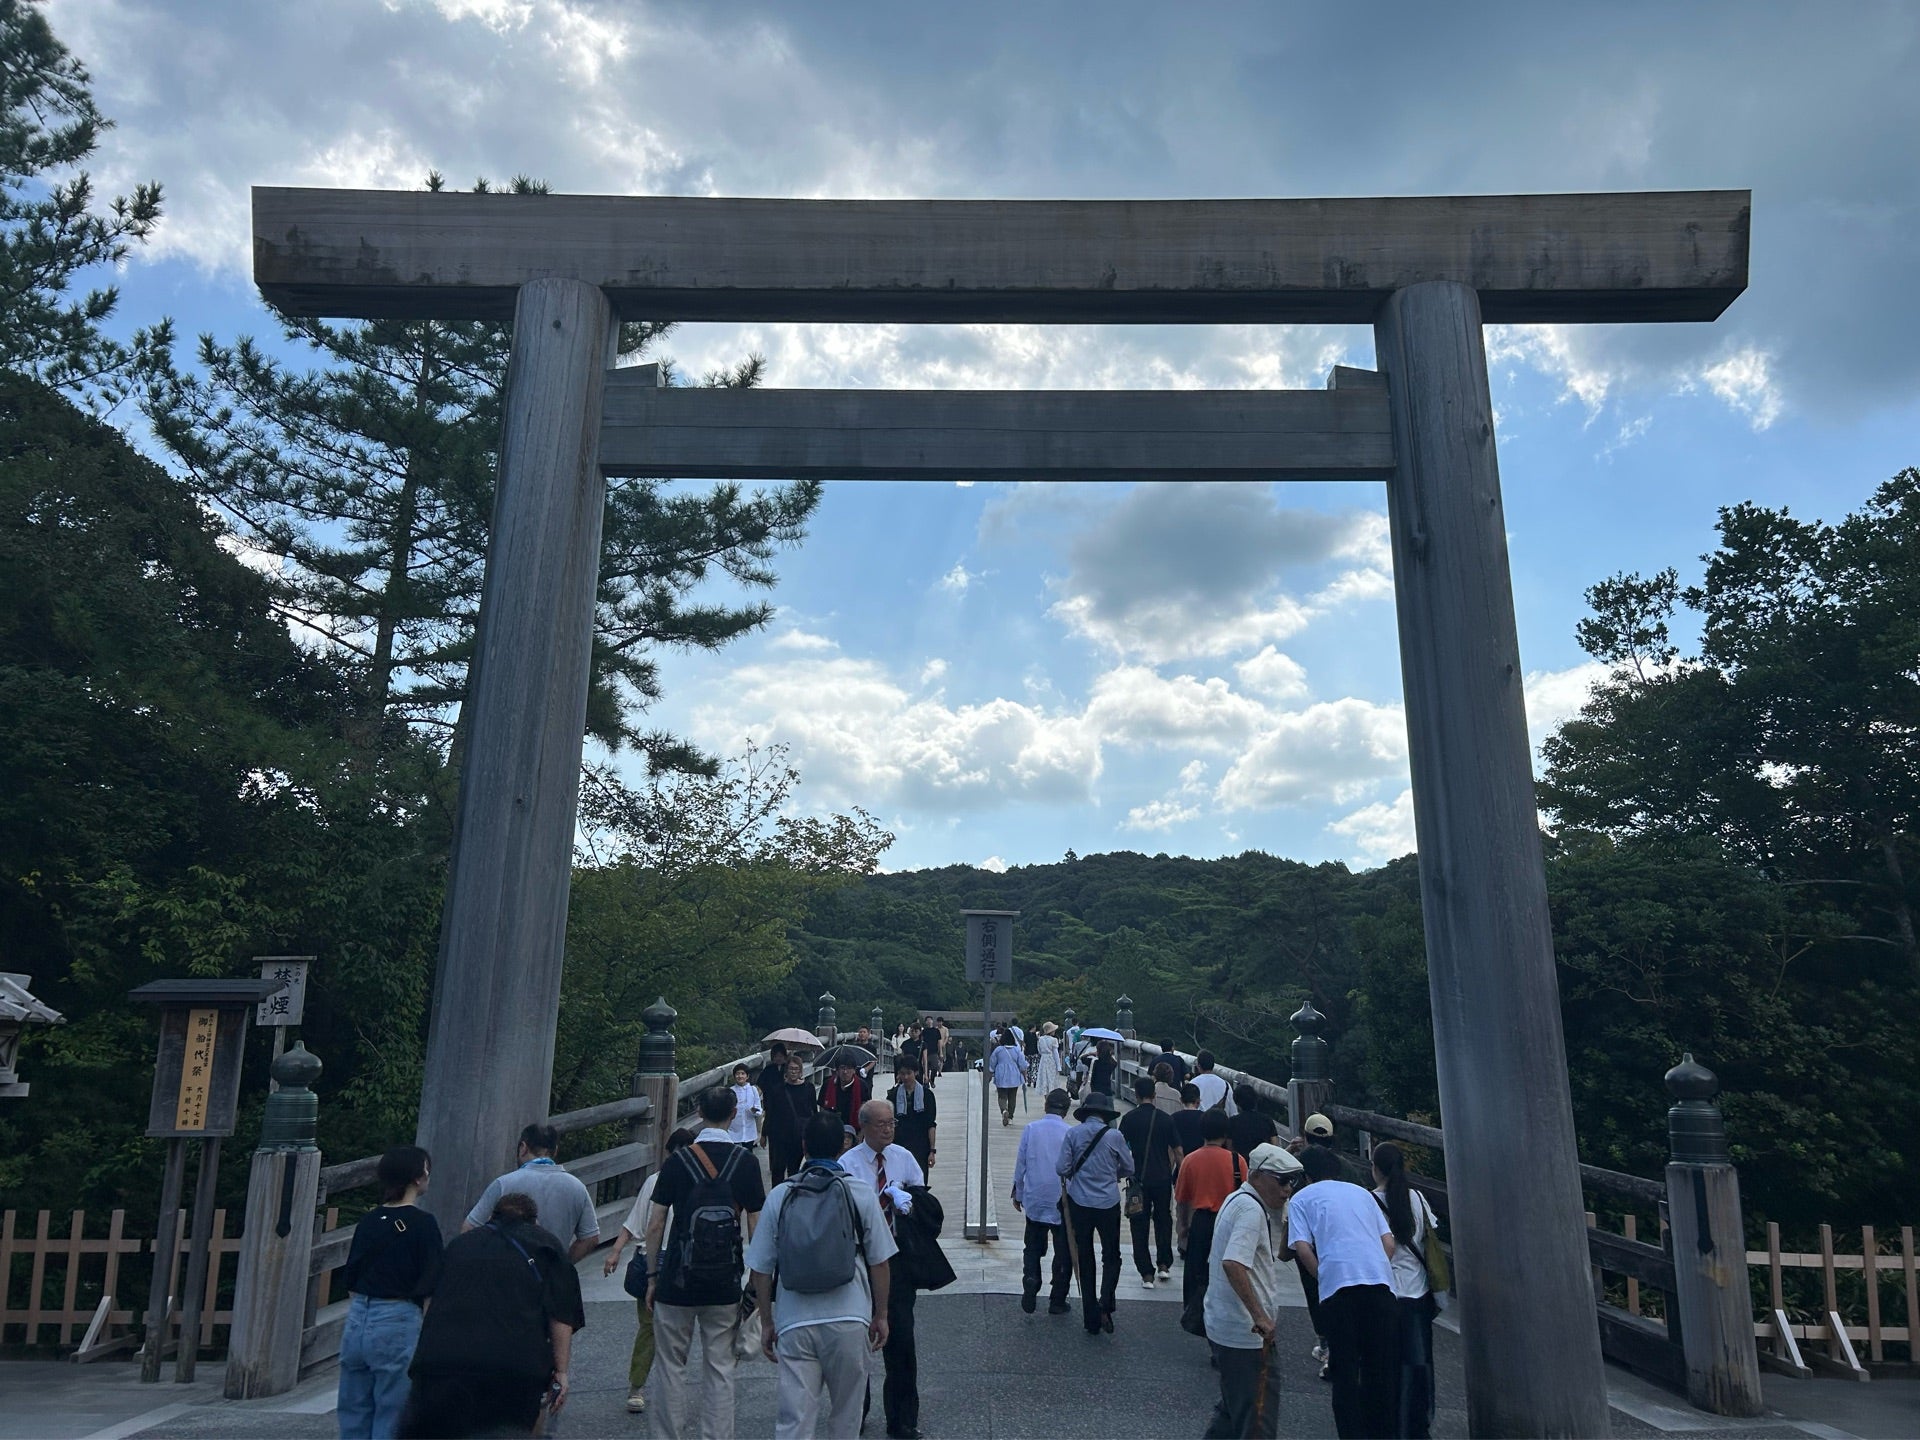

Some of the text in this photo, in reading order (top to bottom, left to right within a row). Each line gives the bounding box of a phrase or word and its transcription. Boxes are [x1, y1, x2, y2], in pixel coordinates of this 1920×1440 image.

[981, 918, 998, 978] 右側通行
[270, 967, 292, 1015] 禁煙
[261, 1007, 268, 1021] です
[193, 1086, 203, 1126] 九月十七日
